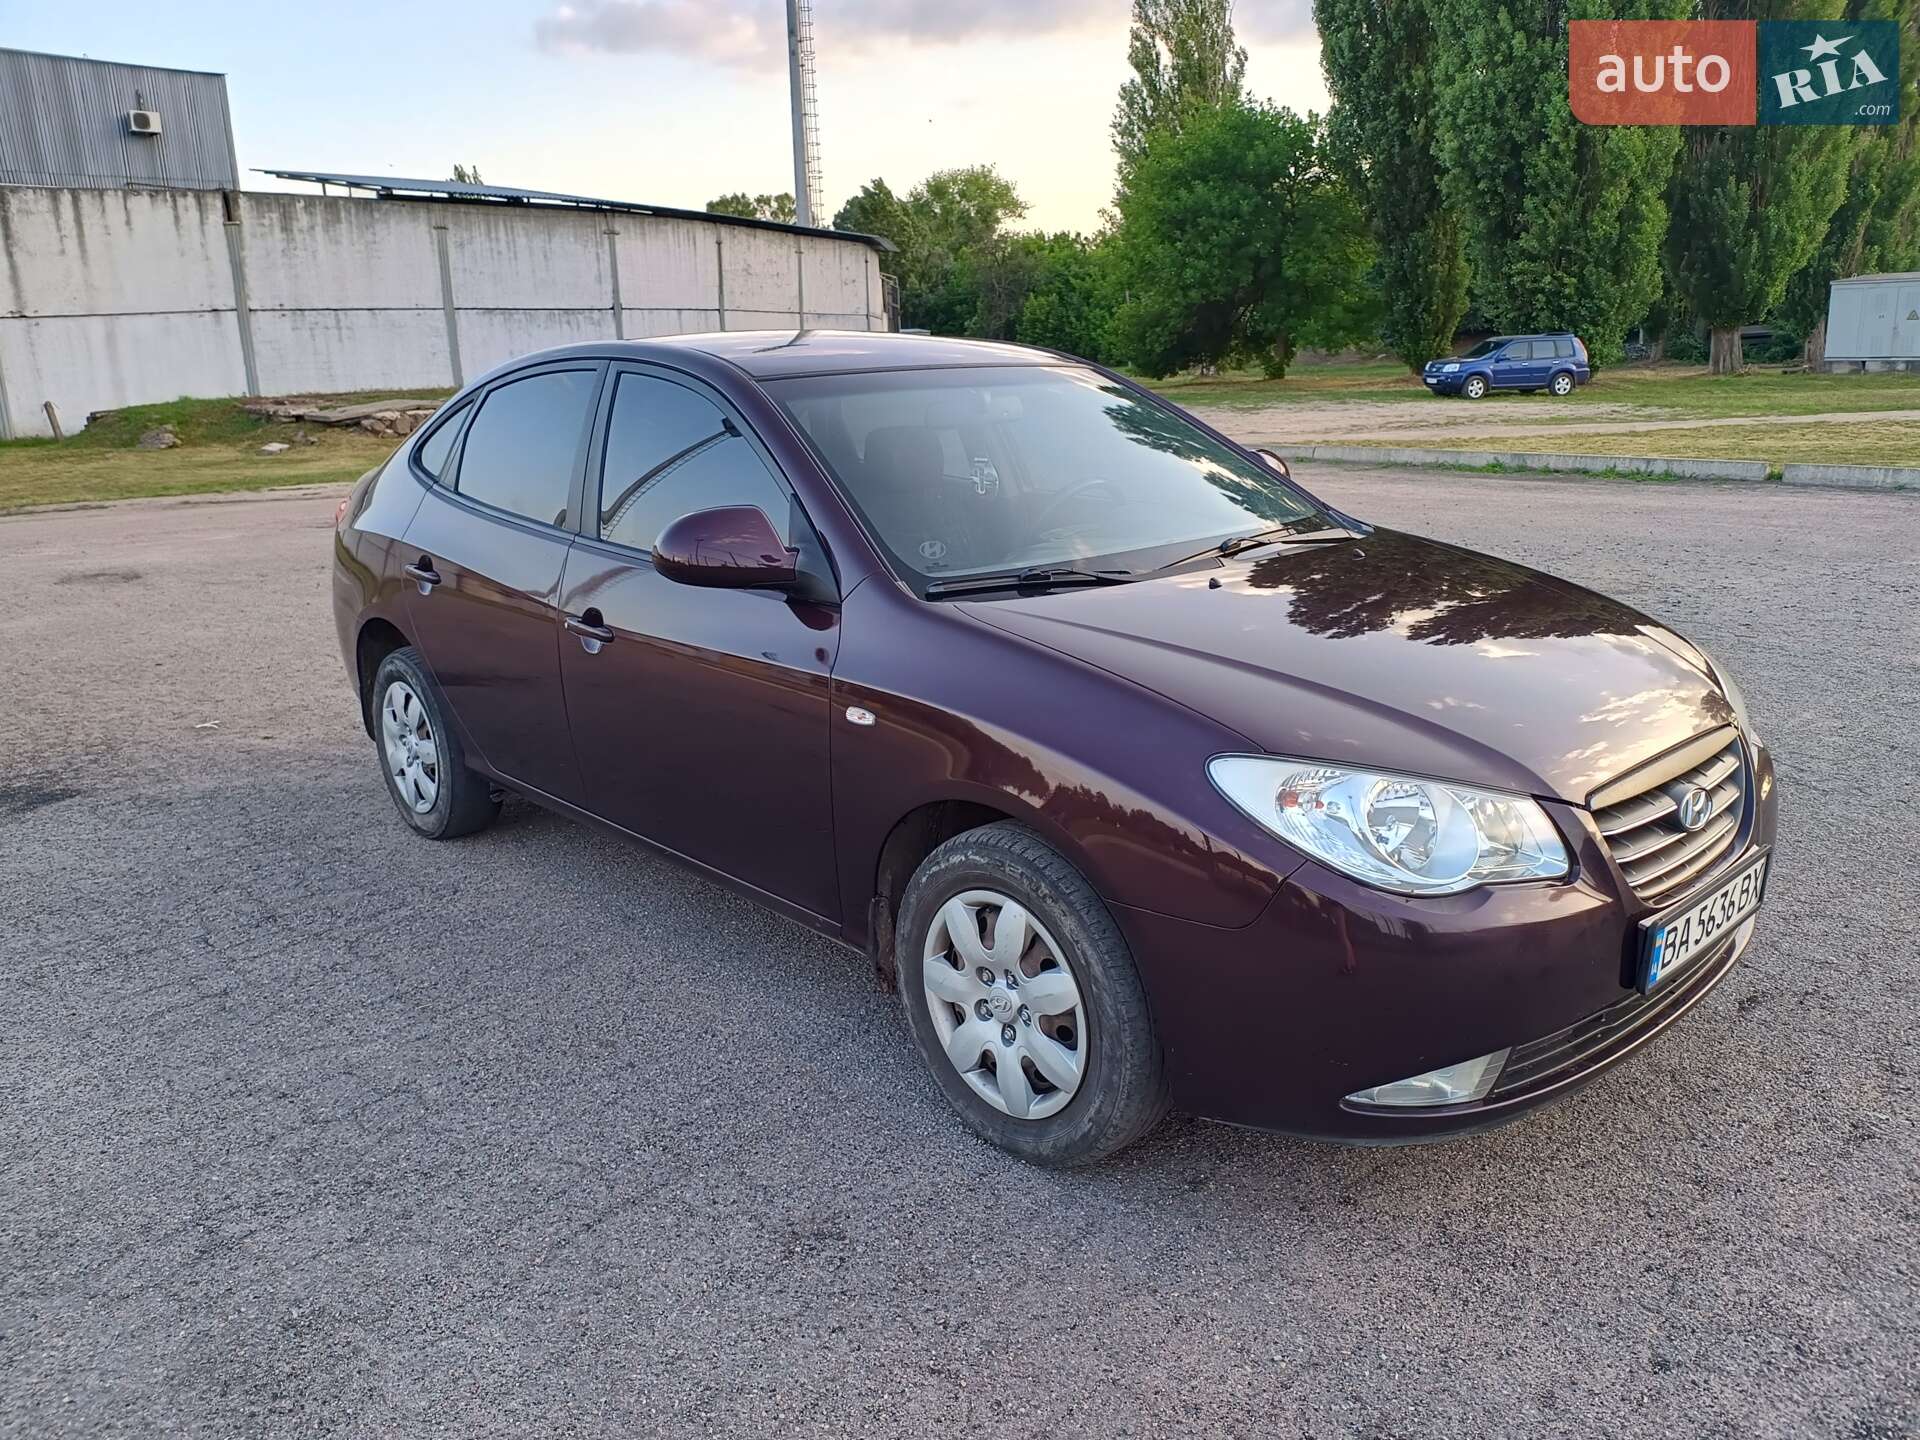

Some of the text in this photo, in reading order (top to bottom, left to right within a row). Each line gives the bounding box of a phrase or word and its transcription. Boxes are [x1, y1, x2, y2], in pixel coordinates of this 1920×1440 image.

[1660, 862, 1765, 970] BA 5636 BX
